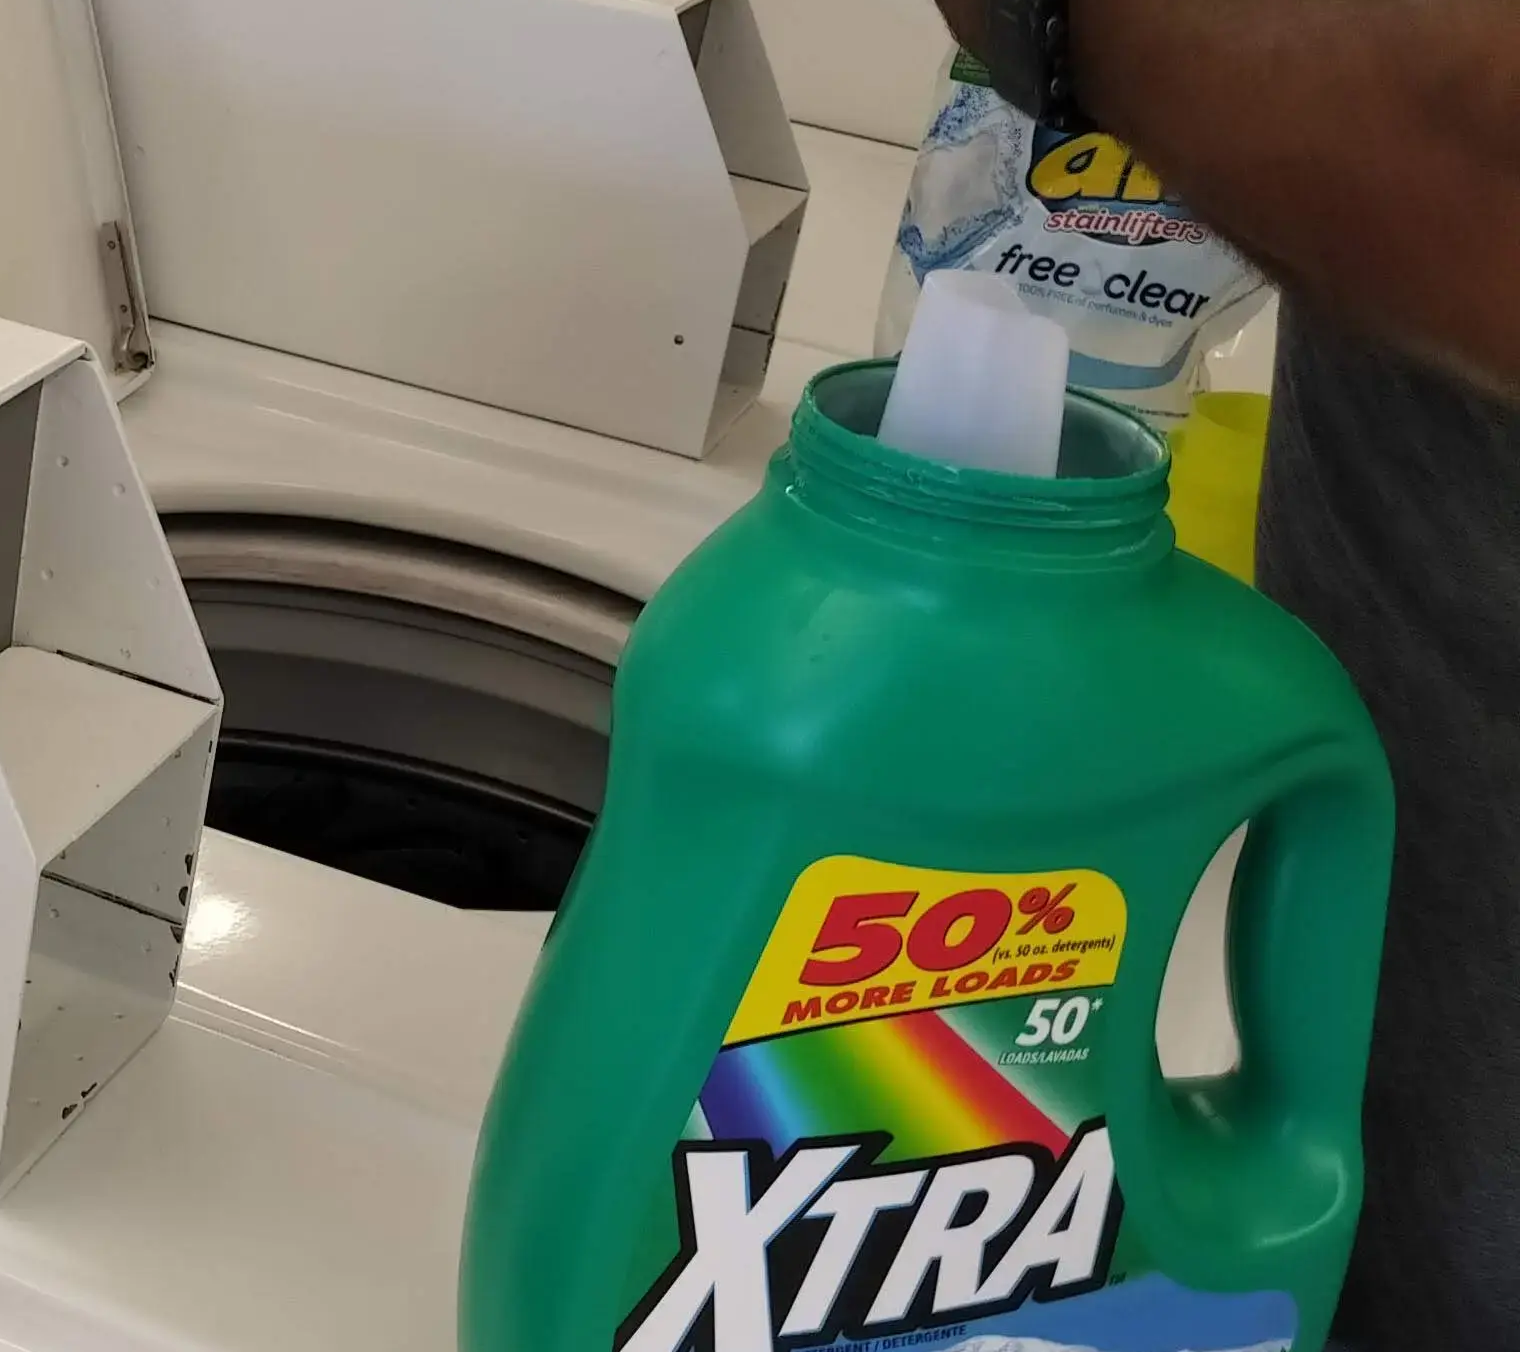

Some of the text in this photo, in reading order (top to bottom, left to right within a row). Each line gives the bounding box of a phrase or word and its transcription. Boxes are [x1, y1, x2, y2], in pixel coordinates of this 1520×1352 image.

[1045, 209, 1206, 244] stainlifters
[995, 244, 1210, 321] free clear
[1018, 282, 1044, 298] 100%
[1046, 289, 1073, 304] FREE
[1087, 301, 1140, 321] perfumes
[797, 883, 1078, 987] 50%
[992, 934, 1116, 965] (vs. 50 oz. detergents)
[780, 959, 1080, 1026] MORE LOADS
[999, 1047, 1090, 1065] LOADS/LAVADAS
[882, 1325, 967, 1351] DETERGENTE
